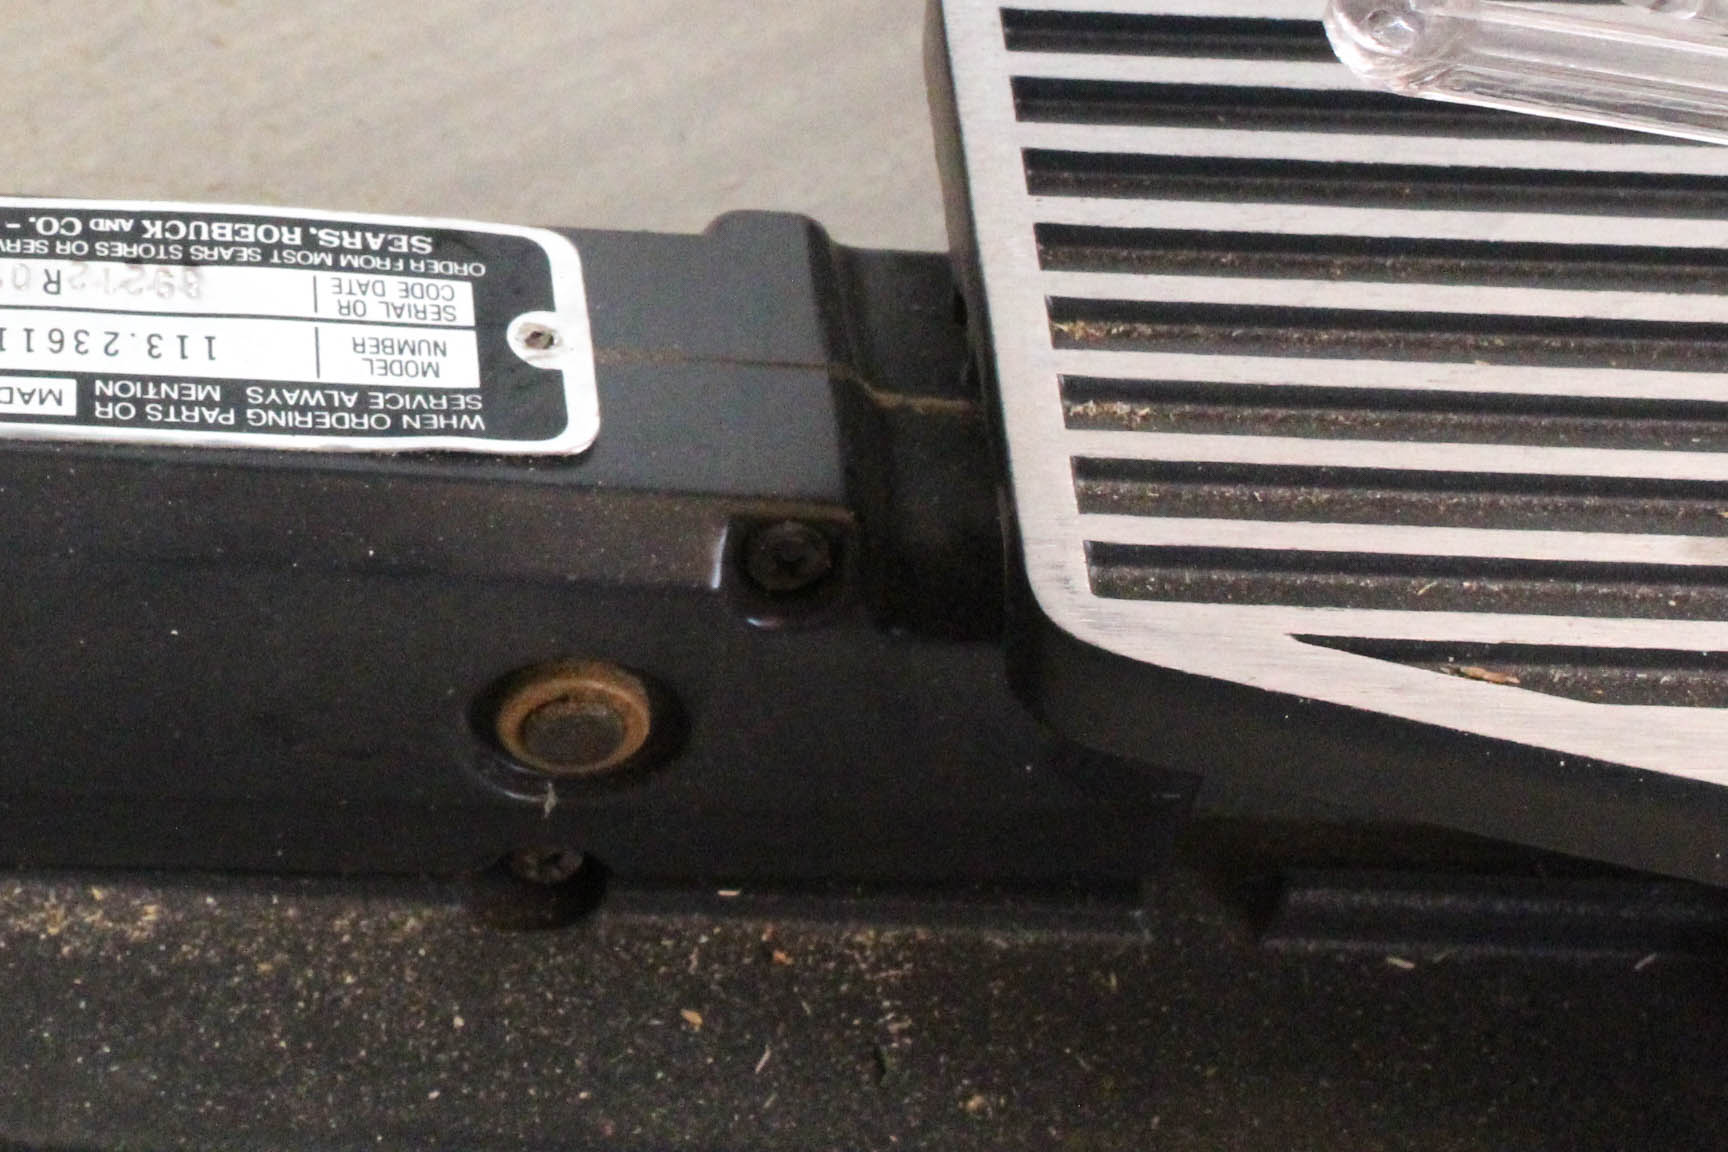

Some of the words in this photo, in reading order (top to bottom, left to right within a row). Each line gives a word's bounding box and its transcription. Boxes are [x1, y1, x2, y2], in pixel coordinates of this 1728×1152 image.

[89, 218, 135, 232] AND
[143, 218, 302, 245] ROEBUCK
[57, 238, 90, 256] OR
[95, 240, 183, 261] STORES
[190, 244, 263, 264] SEARS
[270, 249, 333, 267] MOST
[340, 253, 405, 272] FROM
[410, 259, 486, 278] ORDER
[329, 276, 387, 298] DATE
[398, 279, 456, 302] CODE
[337, 298, 368, 319] OR
[378, 300, 458, 323] SERIAL
[351, 335, 448, 358] NUMBER
[365, 356, 441, 379] MODEL
[94, 379, 221, 401] MENTION
[246, 386, 359, 409] ALWAYS
[368, 390, 483, 411] SERVICE
[94, 400, 137, 422] OR
[147, 403, 236, 426] PARTS
[246, 407, 392, 431] ORDERING
[401, 412, 486, 432] WHEN
